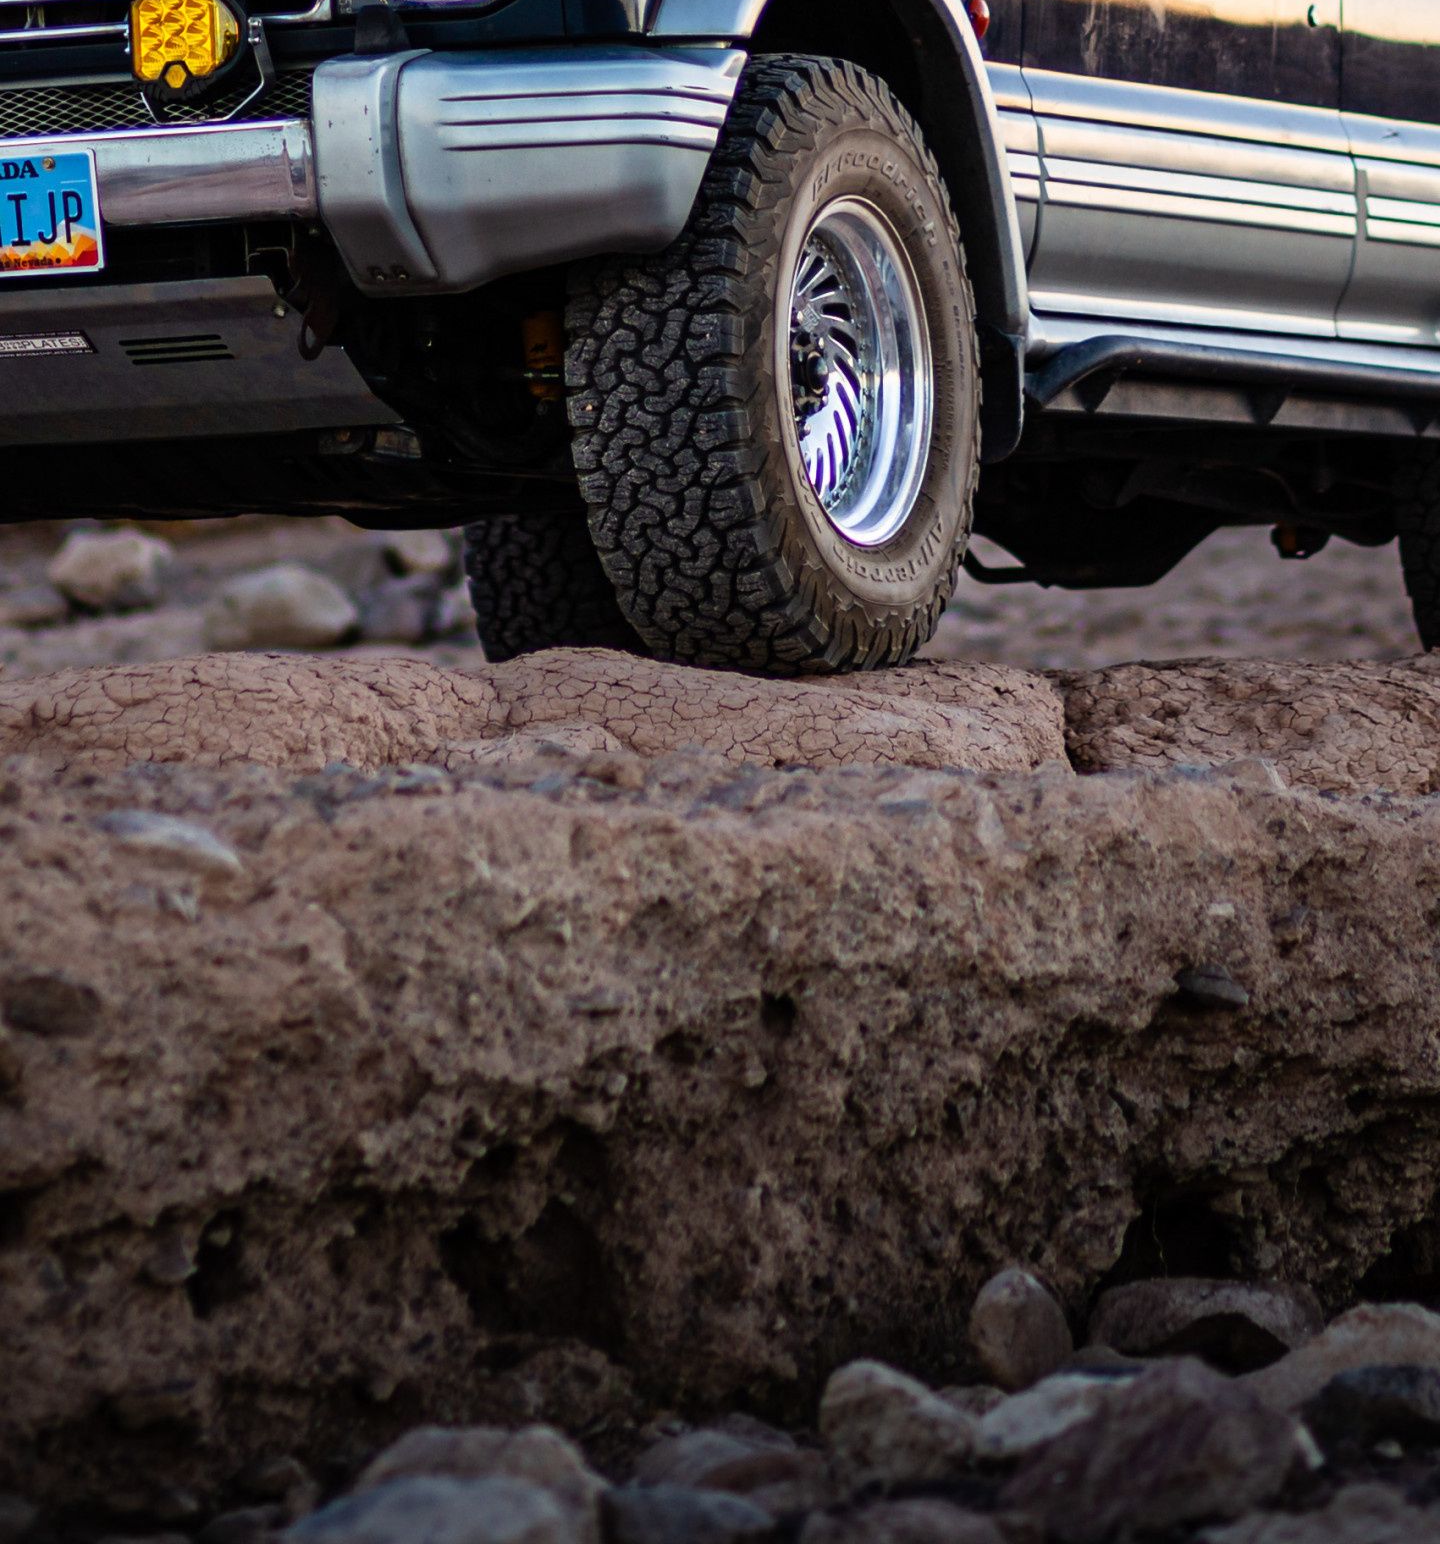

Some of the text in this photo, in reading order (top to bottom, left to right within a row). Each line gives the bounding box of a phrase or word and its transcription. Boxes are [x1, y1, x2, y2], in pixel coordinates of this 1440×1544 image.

[0, 159, 39, 180] DA
[0, 188, 83, 248] IJP
[13, 255, 54, 268] Nevada
